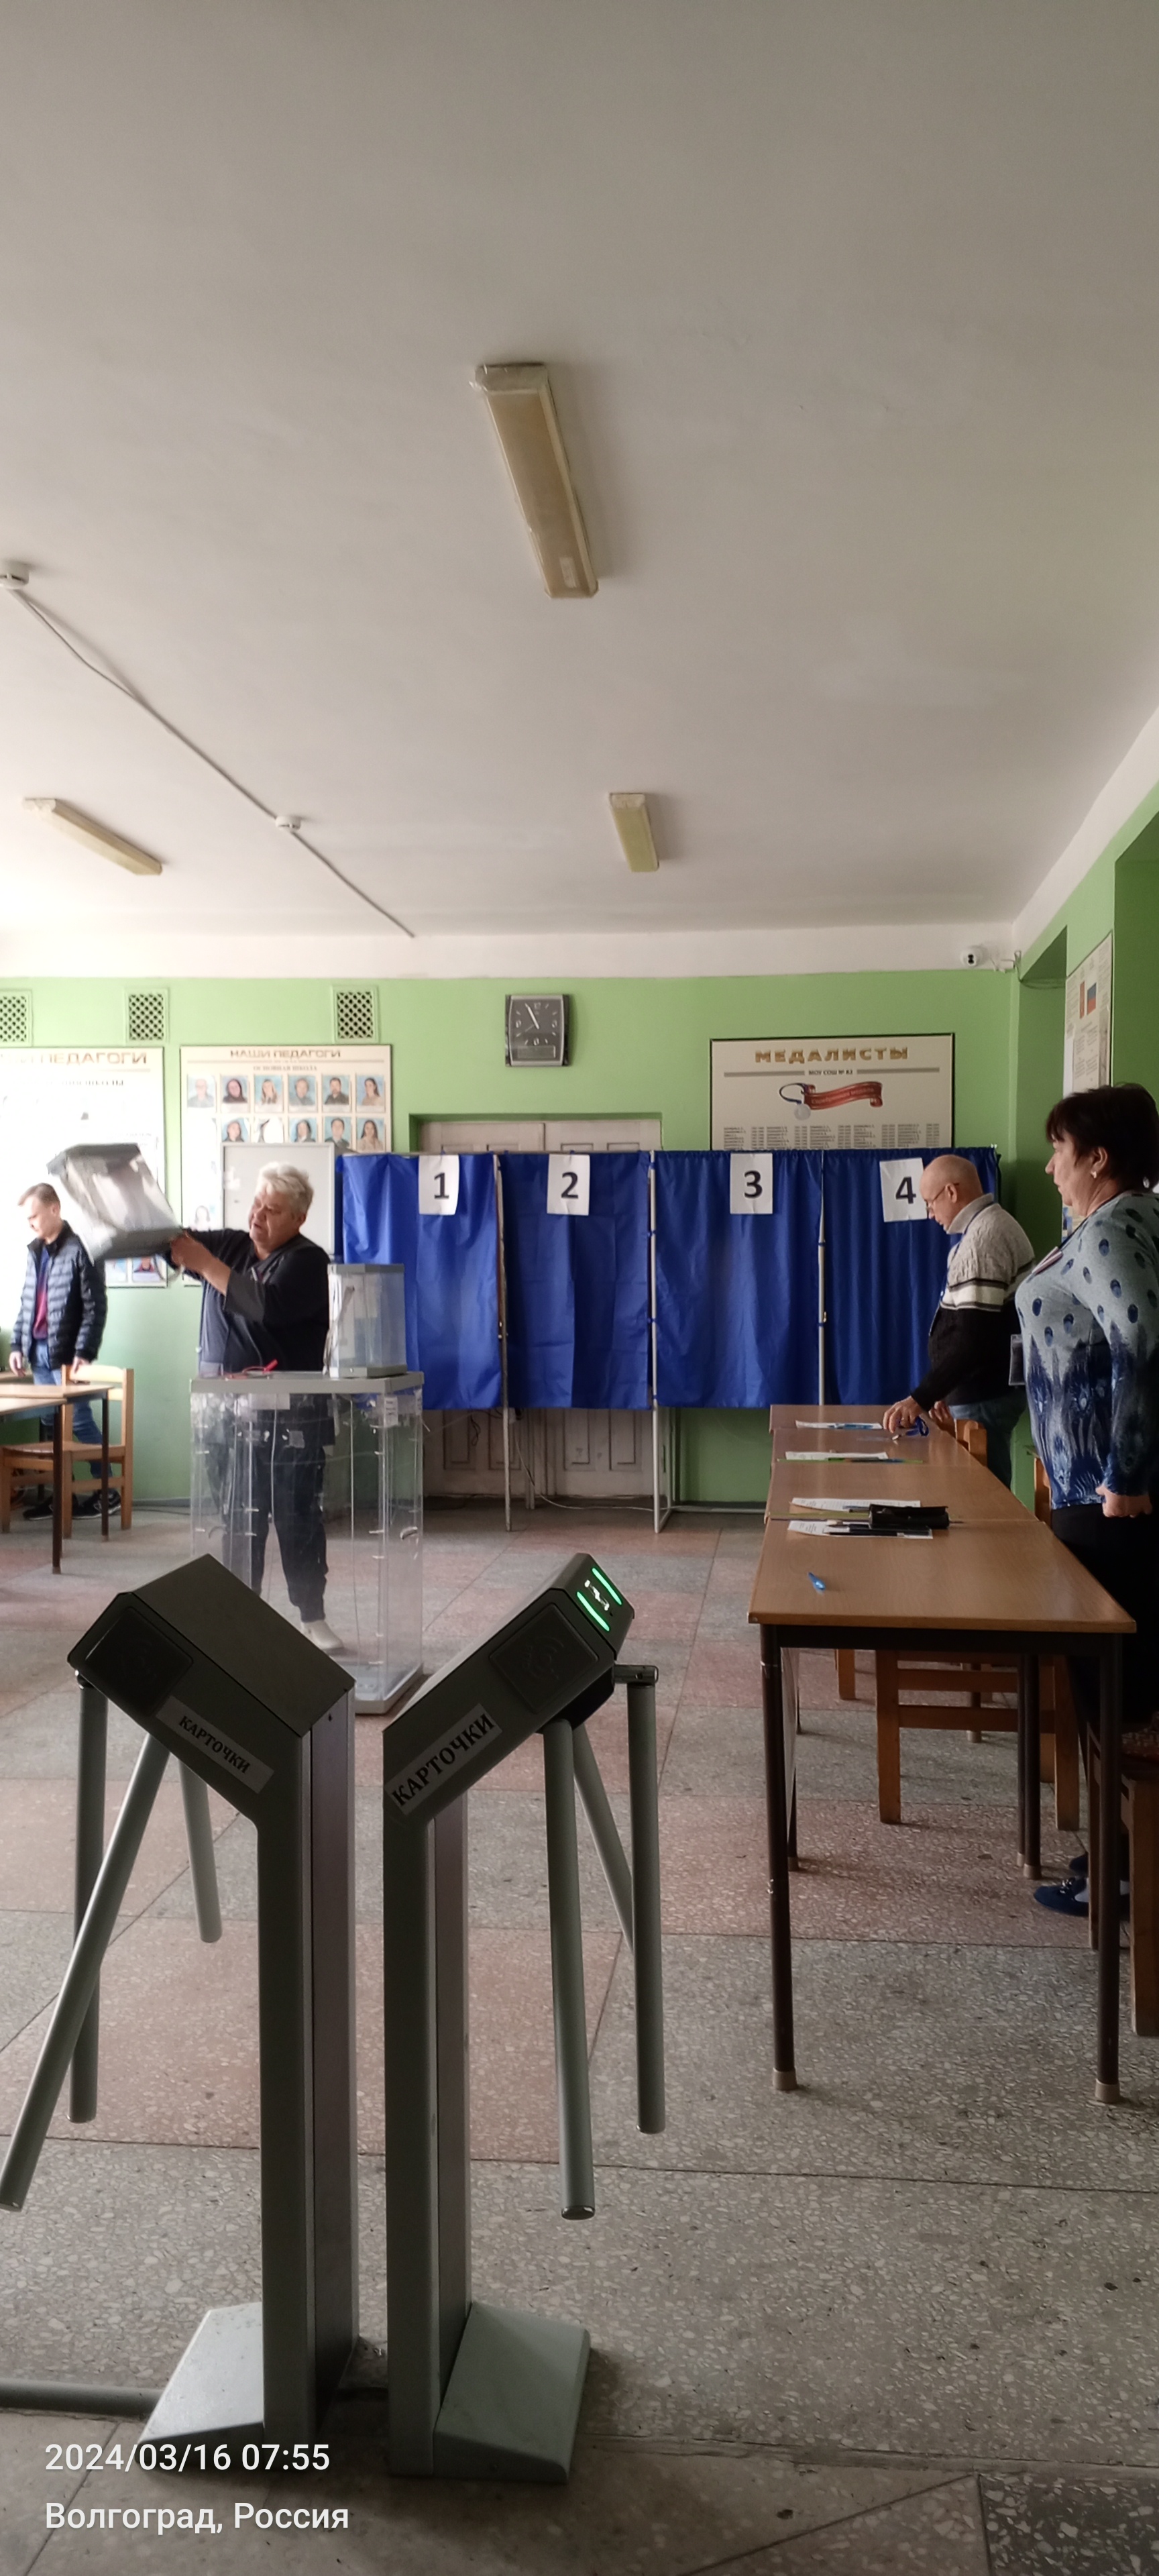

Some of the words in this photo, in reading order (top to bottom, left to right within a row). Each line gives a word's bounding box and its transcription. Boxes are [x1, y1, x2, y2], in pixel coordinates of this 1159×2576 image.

[40, 1052, 147, 1065] ПЕДАГОГИ
[230, 1050, 270, 1058] НАШИ
[274, 1049, 341, 1059] ПЕДАГОГИ
[755, 1046, 908, 1064] МЕДАЛИСТЫ
[434, 1173, 449, 1199] 1
[561, 1172, 578, 1199] 2
[744, 1171, 763, 1199] 3
[895, 1177, 916, 1204] 4
[179, 1715, 251, 1774] КАРТОЧКИ
[392, 1713, 494, 1806] КАРТОЧКИ
